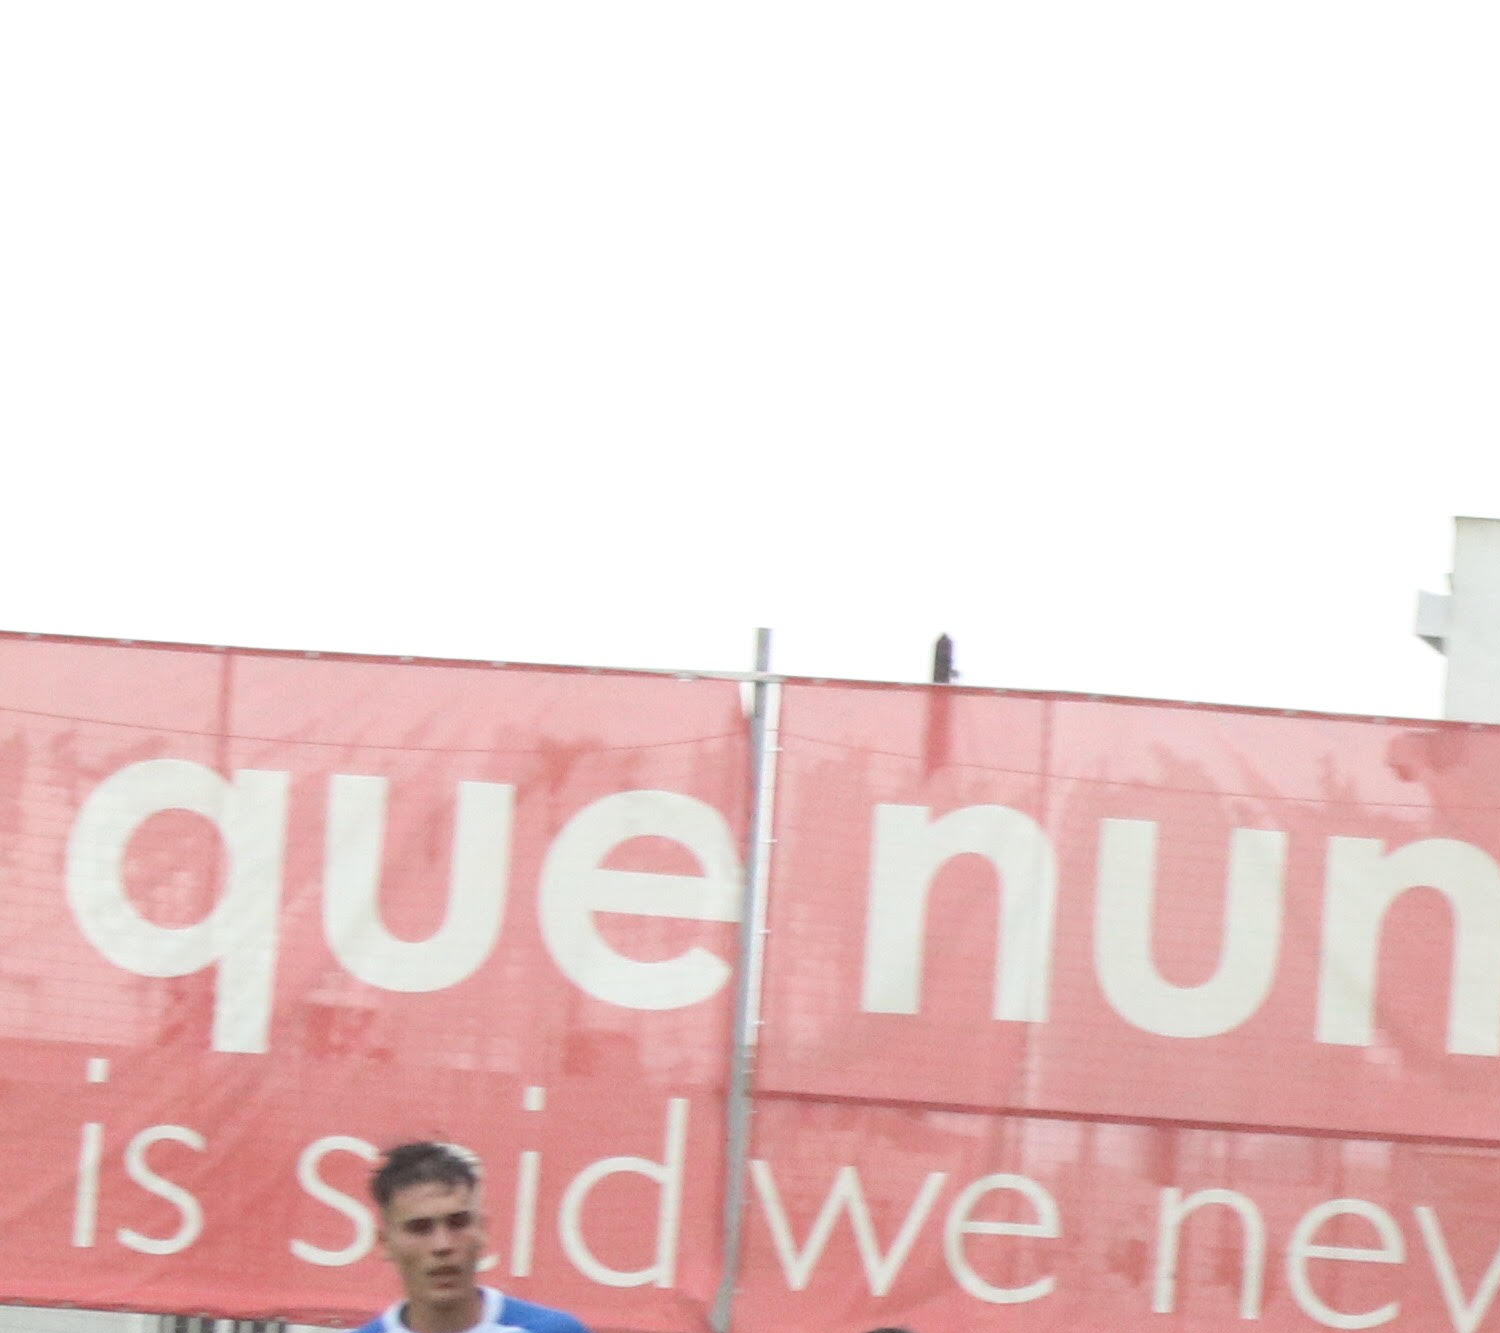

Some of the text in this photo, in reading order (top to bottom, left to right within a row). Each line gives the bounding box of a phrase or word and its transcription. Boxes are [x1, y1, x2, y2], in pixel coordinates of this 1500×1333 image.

[66, 759, 743, 1054] que
[72, 1057, 207, 1256] is
[290, 1086, 689, 1289] sid
[750, 1158, 1061, 1304] we
